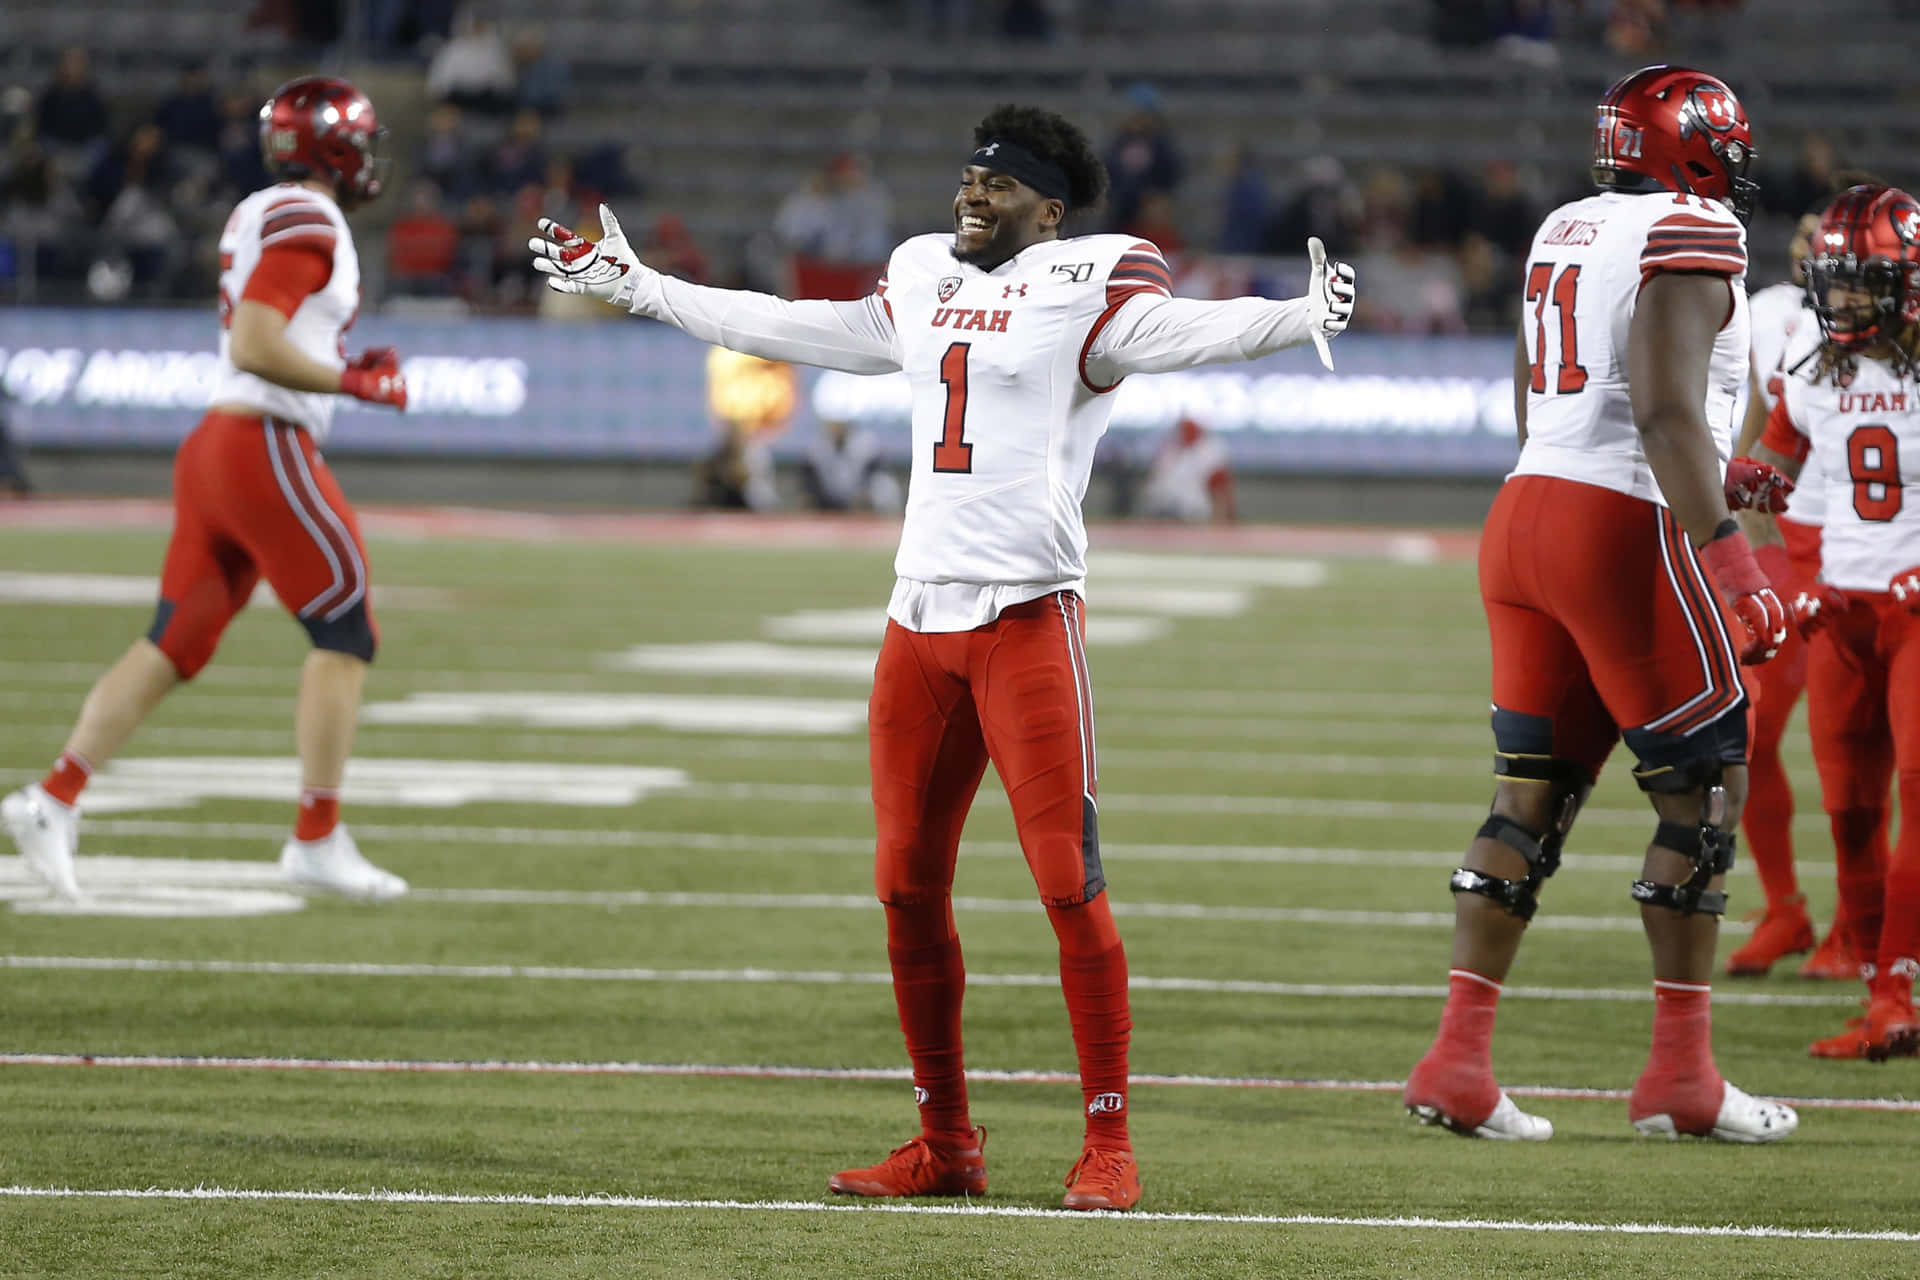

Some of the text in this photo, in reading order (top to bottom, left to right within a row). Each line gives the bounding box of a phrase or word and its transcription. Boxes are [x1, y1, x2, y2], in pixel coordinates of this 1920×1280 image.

[1617, 128, 1644, 158] 71
[931, 308, 1012, 332] UTAH
[1526, 261, 1589, 395] 71
[933, 341, 973, 474] 1
[1839, 391, 1908, 413] UTAH
[1847, 425, 1903, 522] 8
